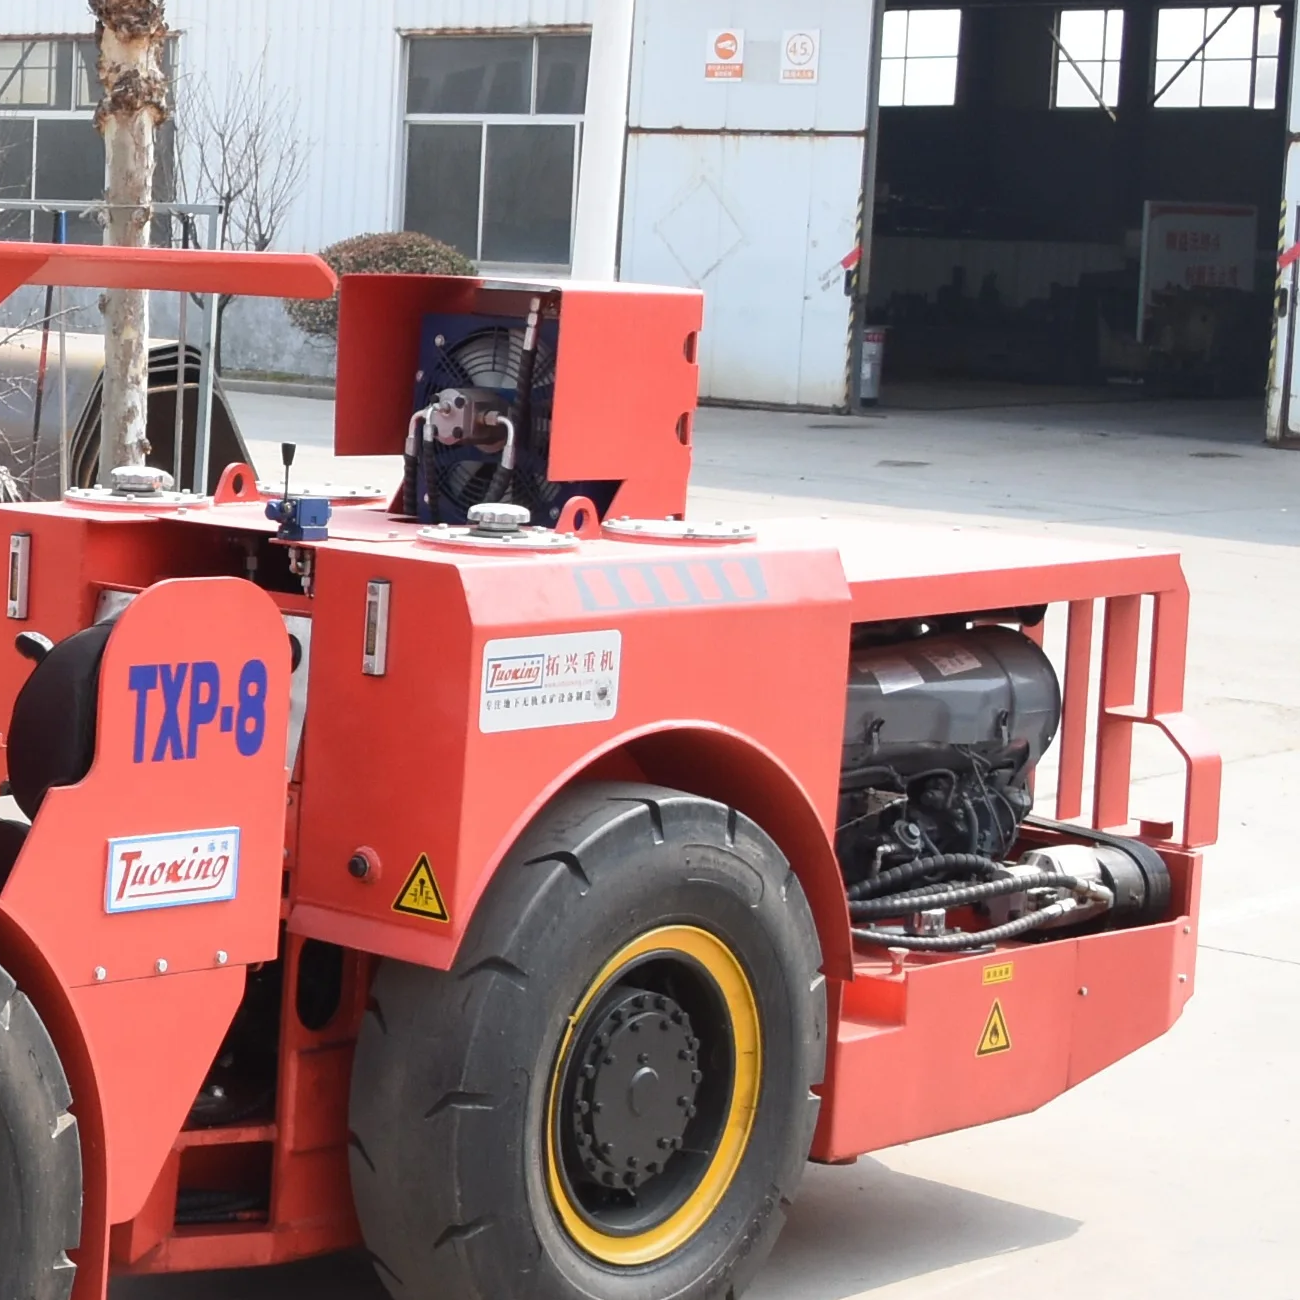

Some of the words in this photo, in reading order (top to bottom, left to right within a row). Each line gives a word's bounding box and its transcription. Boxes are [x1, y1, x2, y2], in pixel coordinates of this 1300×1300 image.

[545, 649, 614, 677] 拓兴重机
[128, 659, 268, 764] TXP-8
[115, 846, 230, 902] Tuoxing
